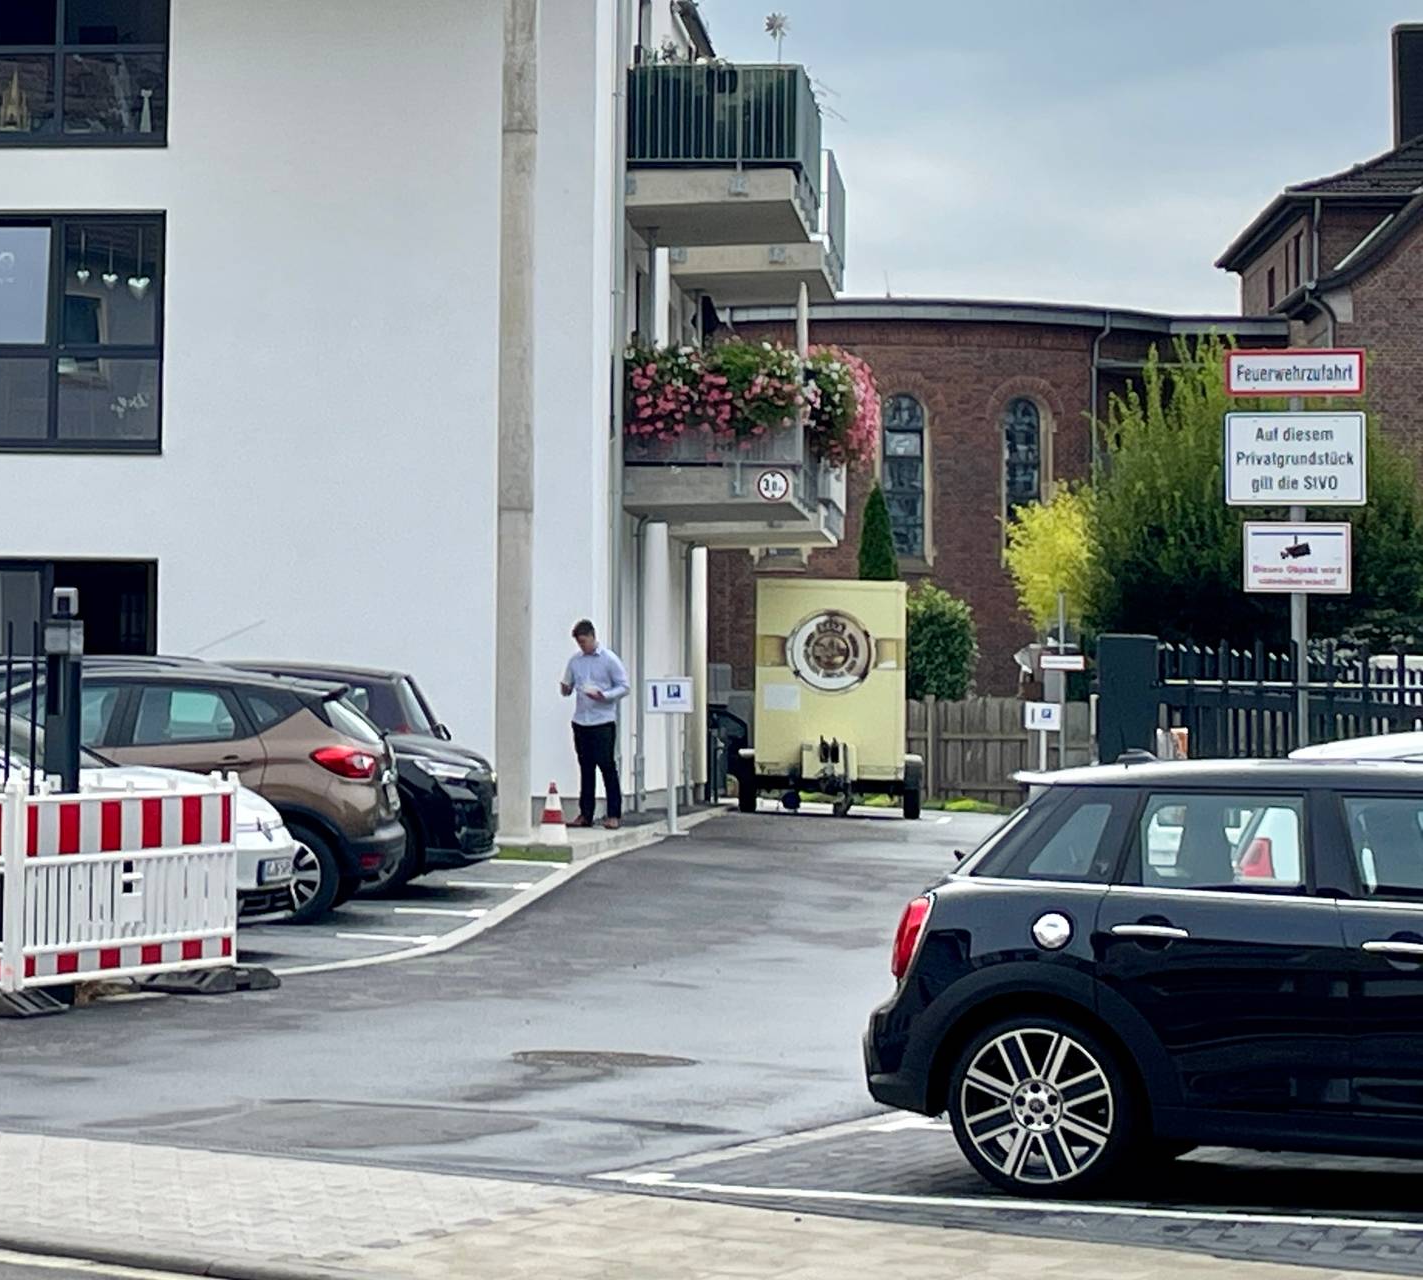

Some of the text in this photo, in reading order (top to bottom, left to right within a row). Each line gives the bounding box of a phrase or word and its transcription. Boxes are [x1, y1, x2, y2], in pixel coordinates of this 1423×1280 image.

[1236, 364, 1353, 382] Feuerwehrzufahrt
[1255, 427, 1334, 441] Auf diesem
[1235, 451, 1354, 469] Privatgrundstück
[1277, 475, 1299, 490] die
[1303, 475, 1339, 490] StVO
